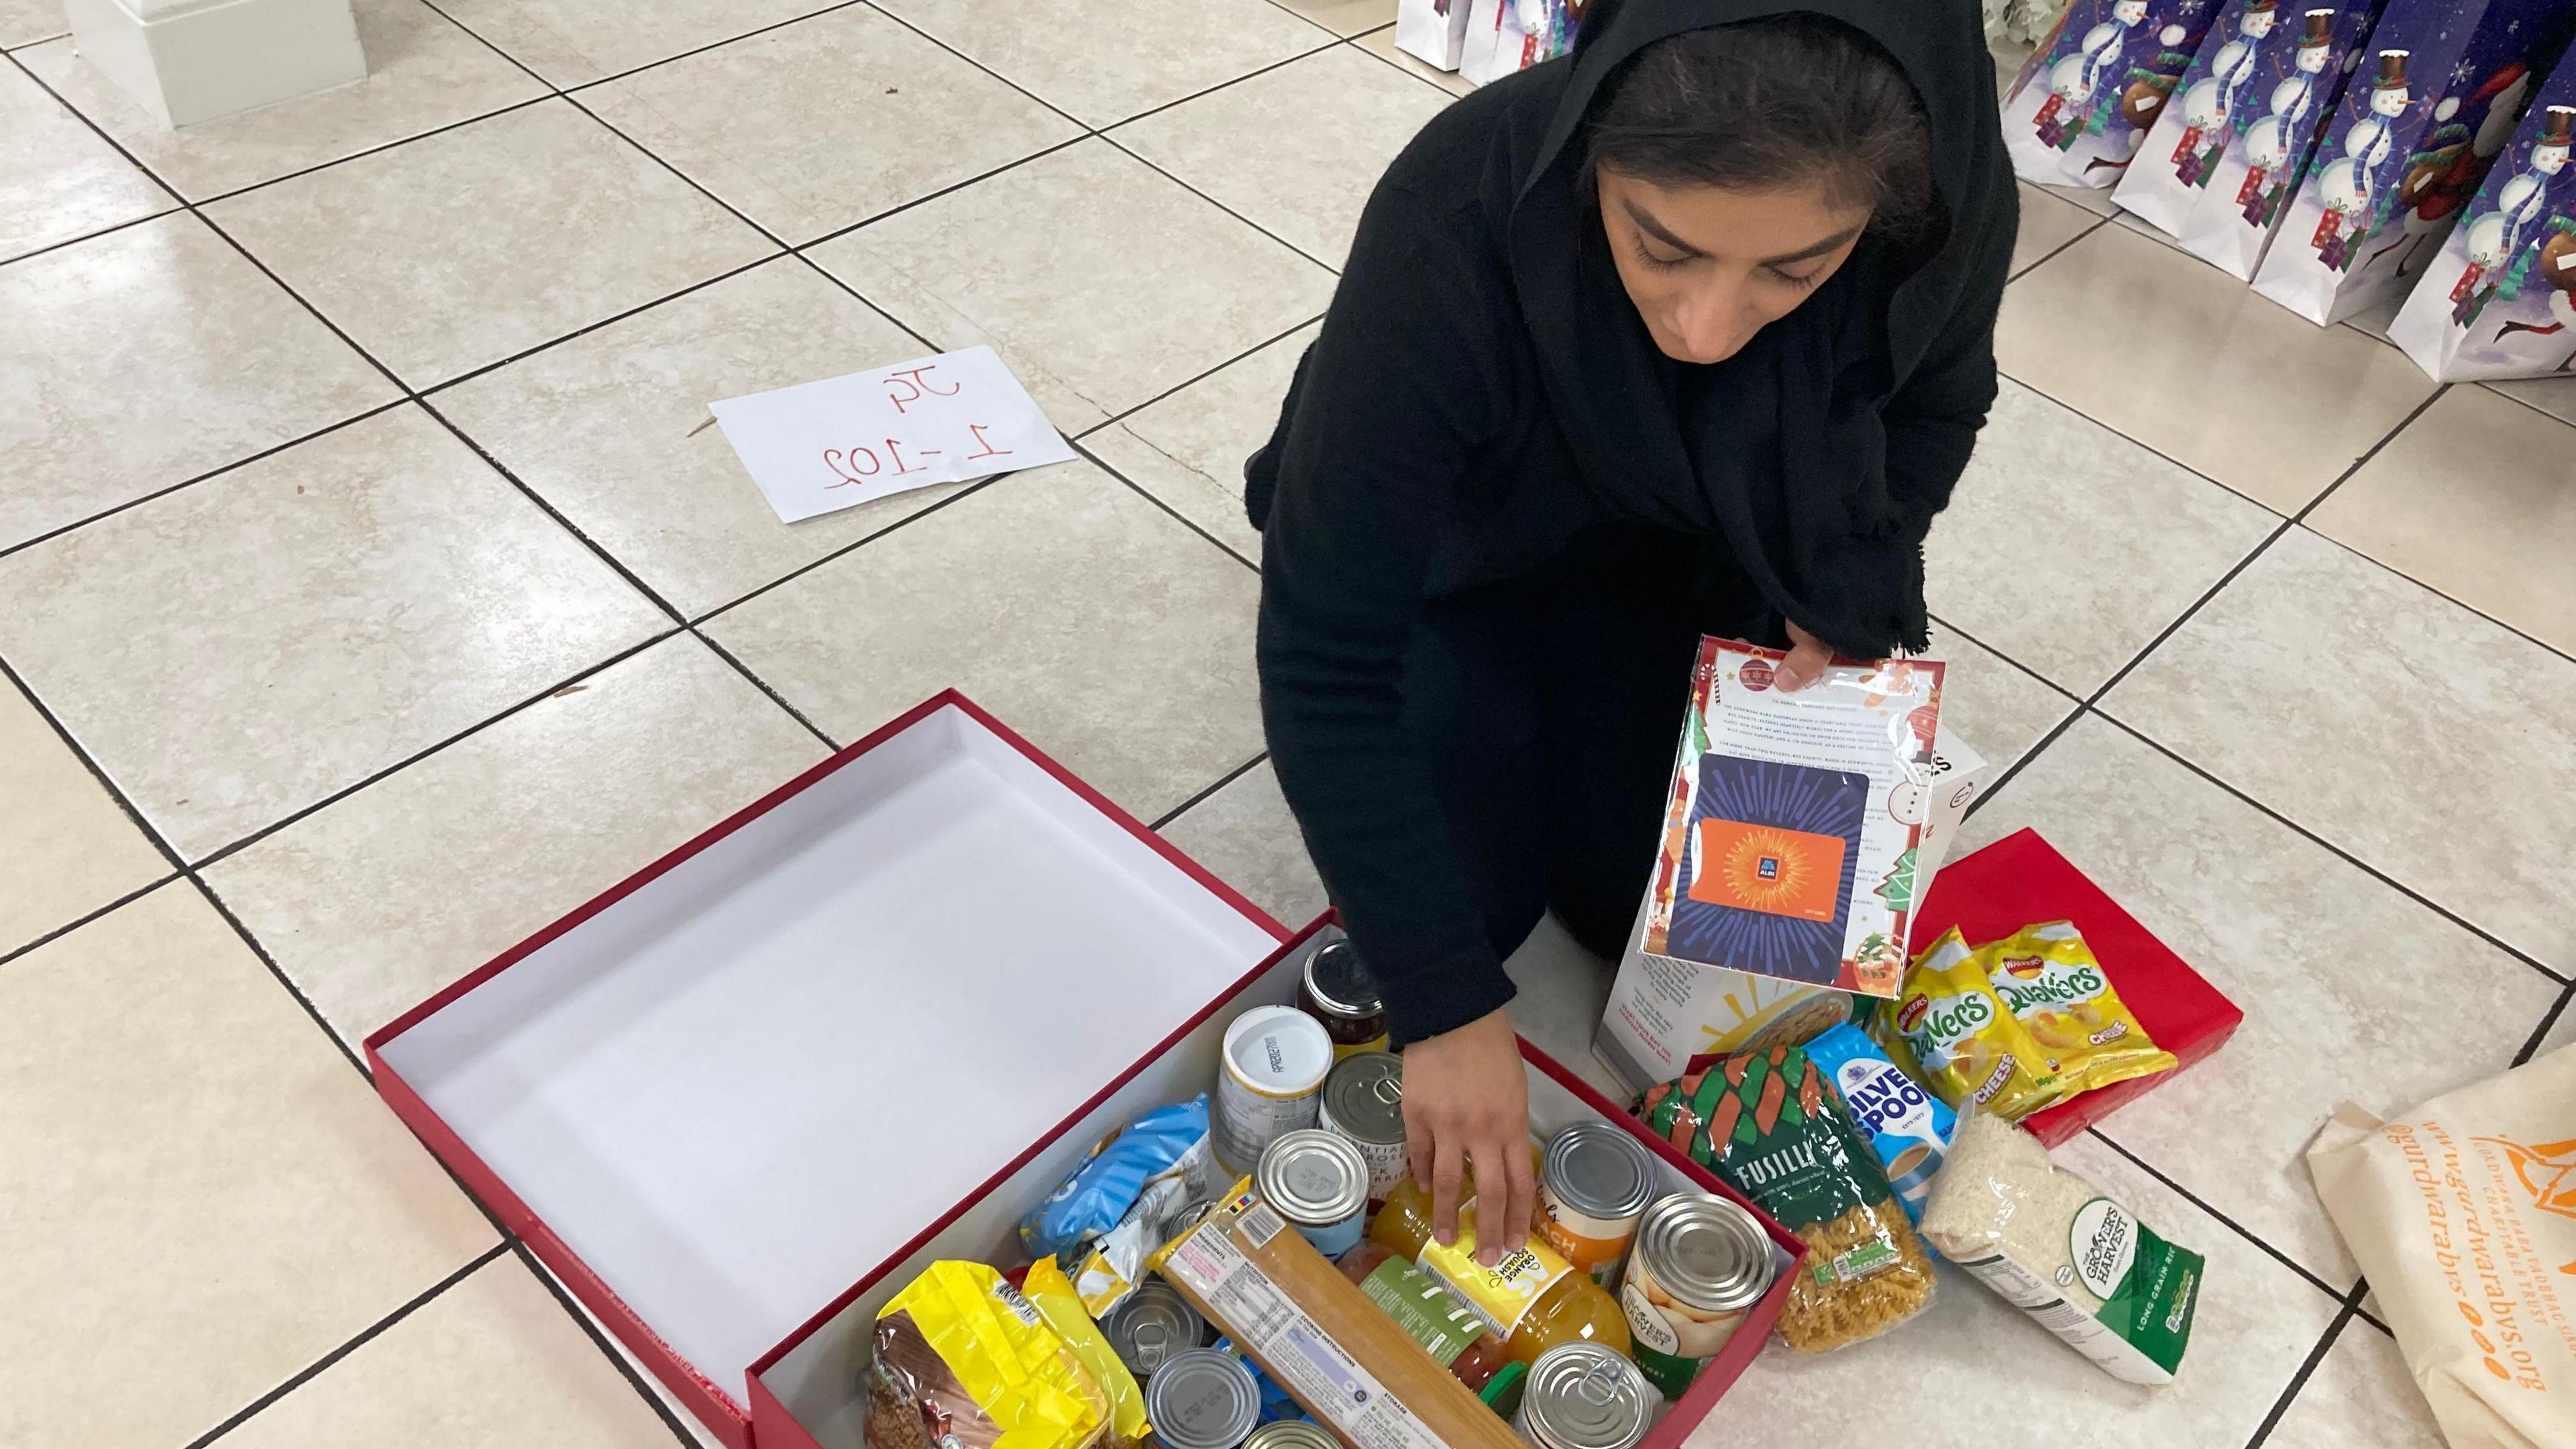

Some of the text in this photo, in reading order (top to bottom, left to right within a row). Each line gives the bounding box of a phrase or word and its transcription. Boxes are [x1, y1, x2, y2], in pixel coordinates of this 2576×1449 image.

[1898, 996, 1928, 1027] WALKERS
[1976, 1053, 2016, 1104] CHEESE
[1195, 1231, 1226, 1260] INGREDIENTS
[1498, 1247, 1529, 1275] SQUASH
[2095, 1216, 2129, 1285] HARVEST
[1243, 1260, 1269, 1285] NUTRITION
[1504, 1252, 1536, 1283] ORANGE
[2508, 1219, 2534, 1254] BABA
[2526, 1258, 2565, 1321] VADBHAG
[2137, 1303, 2154, 1332] LONG
[2151, 1266, 2169, 1299] GRAIN
[2518, 1283, 2549, 1325] TRUST
[1299, 1314, 1356, 1368] COOKING INSTRUCTIONS
[1383, 1391, 1407, 1415] STORAGE
